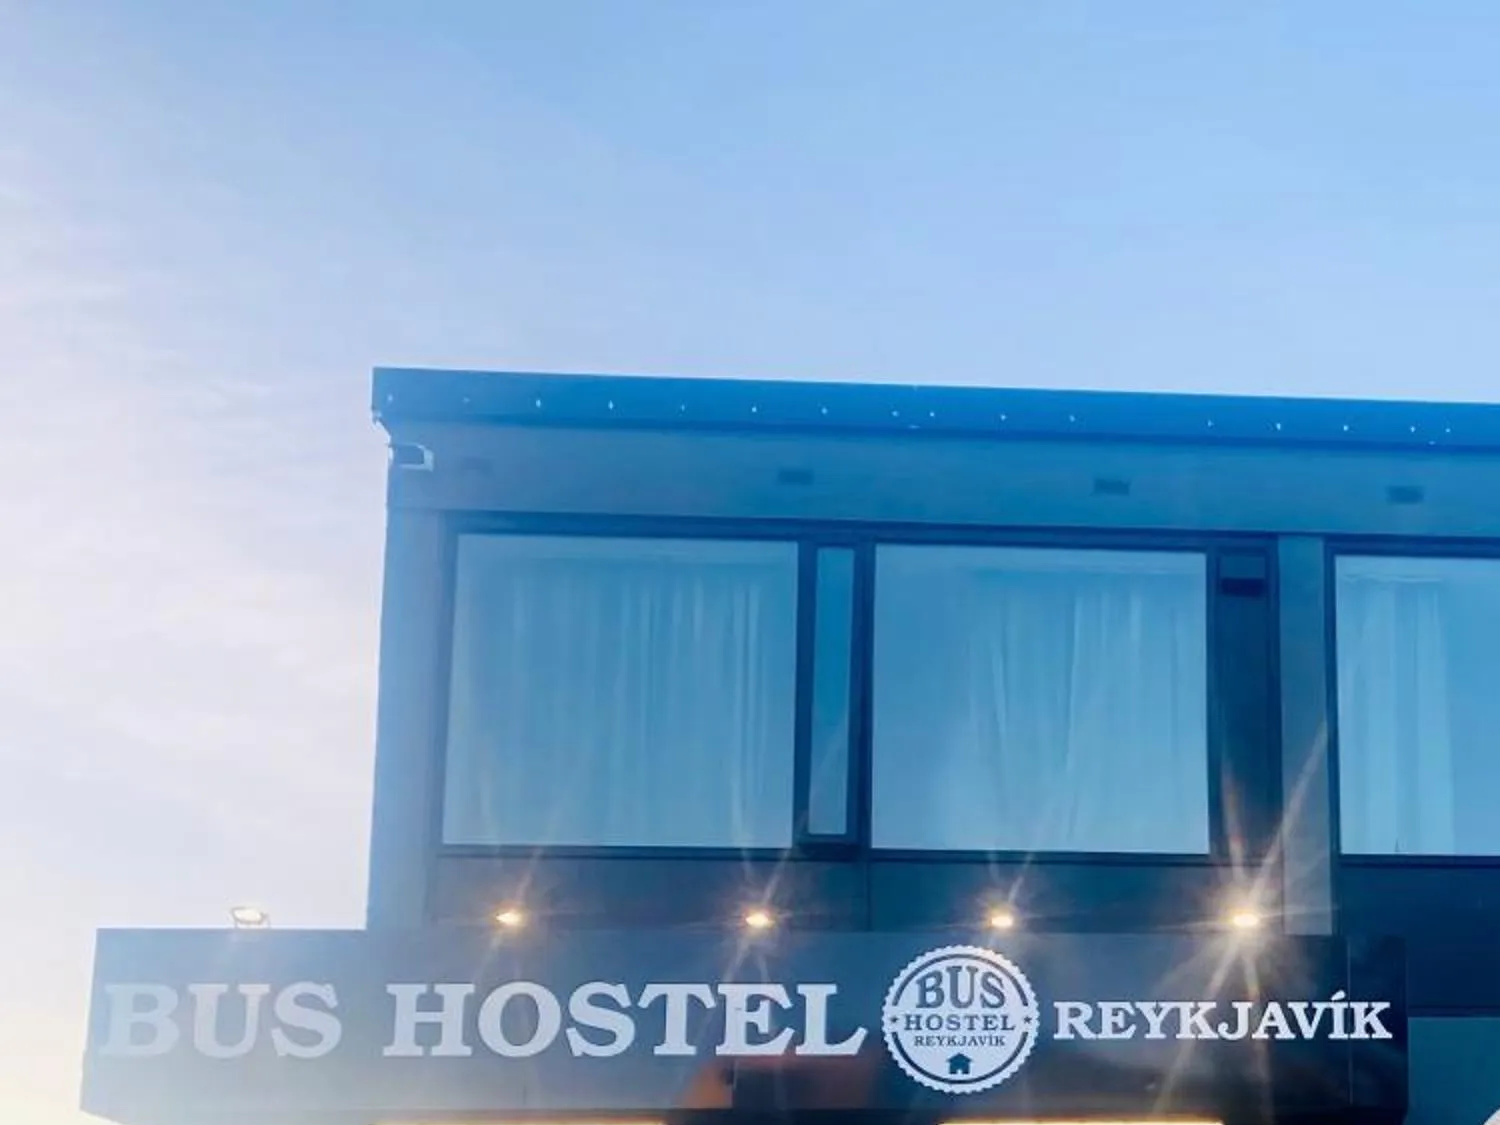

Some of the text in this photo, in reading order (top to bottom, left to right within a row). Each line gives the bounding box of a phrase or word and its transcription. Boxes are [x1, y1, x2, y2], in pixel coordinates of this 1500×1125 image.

[915, 965, 1006, 1008] BUS
[102, 981, 867, 1058] BUS HOSTEL
[904, 1014, 1015, 1030] HOSTEL
[1053, 991, 1393, 1040] REYKJAVÍK
